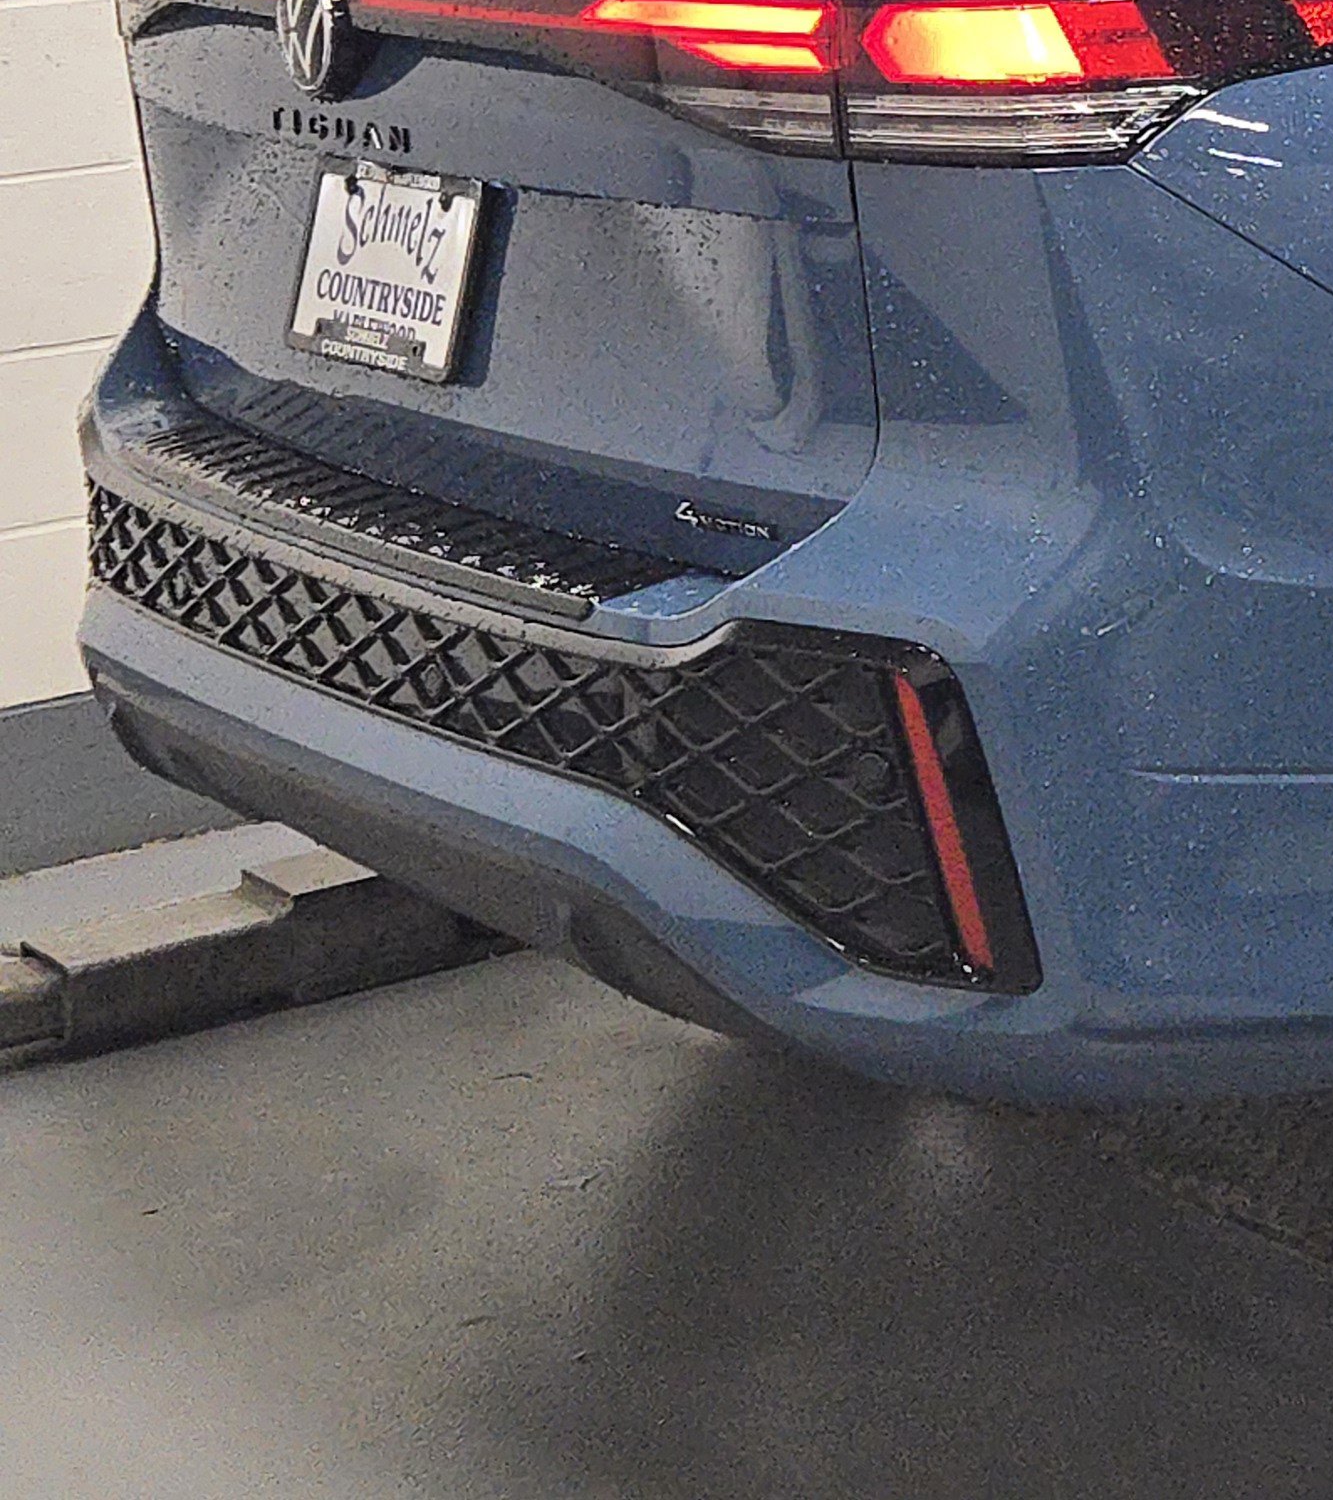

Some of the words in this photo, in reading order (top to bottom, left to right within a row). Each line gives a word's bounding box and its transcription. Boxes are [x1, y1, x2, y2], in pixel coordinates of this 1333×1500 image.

[337, 182, 445, 285] Schmelz
[317, 268, 446, 327] COUNTRYSIDE
[321, 339, 408, 371] COUNTRYSIDE
